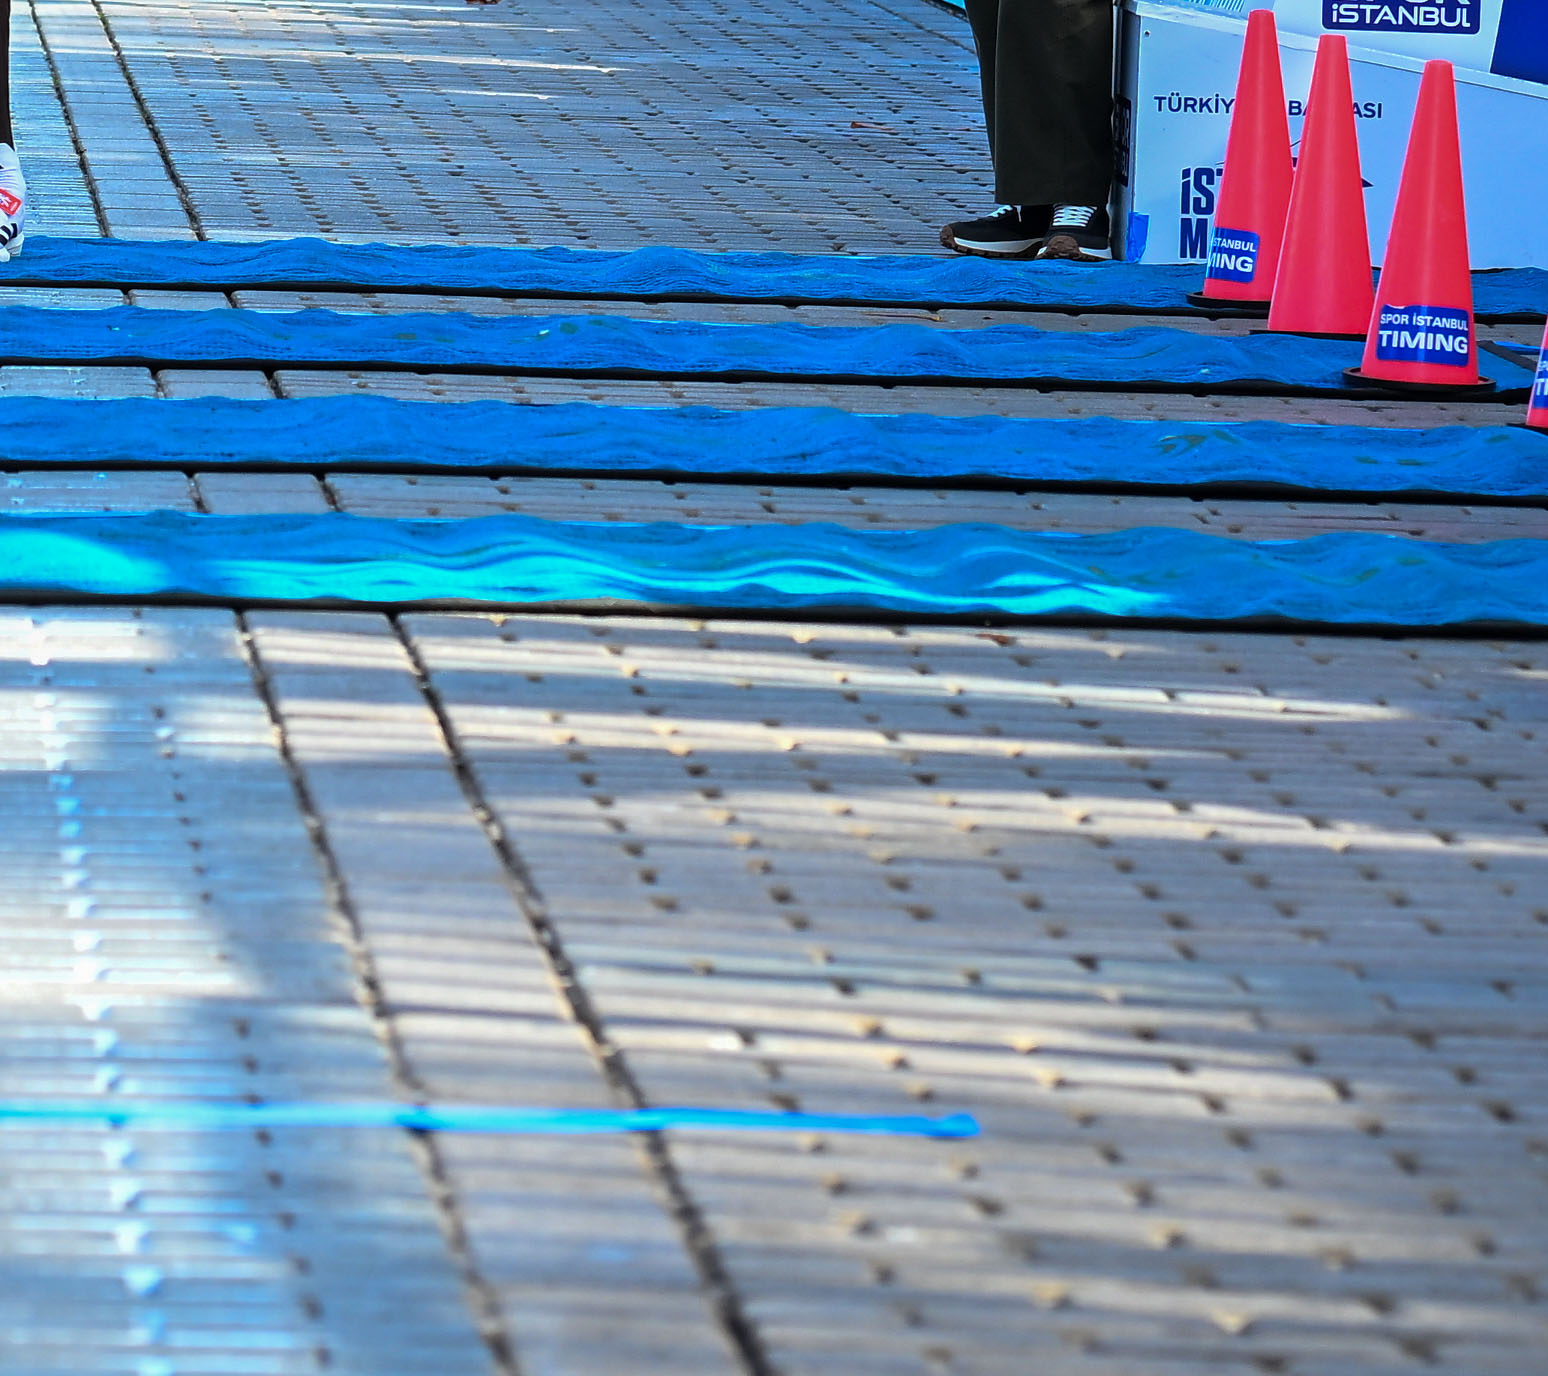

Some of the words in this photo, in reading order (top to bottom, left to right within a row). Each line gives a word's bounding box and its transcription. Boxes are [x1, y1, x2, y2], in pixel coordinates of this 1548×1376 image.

[1381, 312, 1409, 326] SPOR
[1413, 313, 1468, 332] İSTANBUL
[1379, 330, 1468, 354] TIMING
